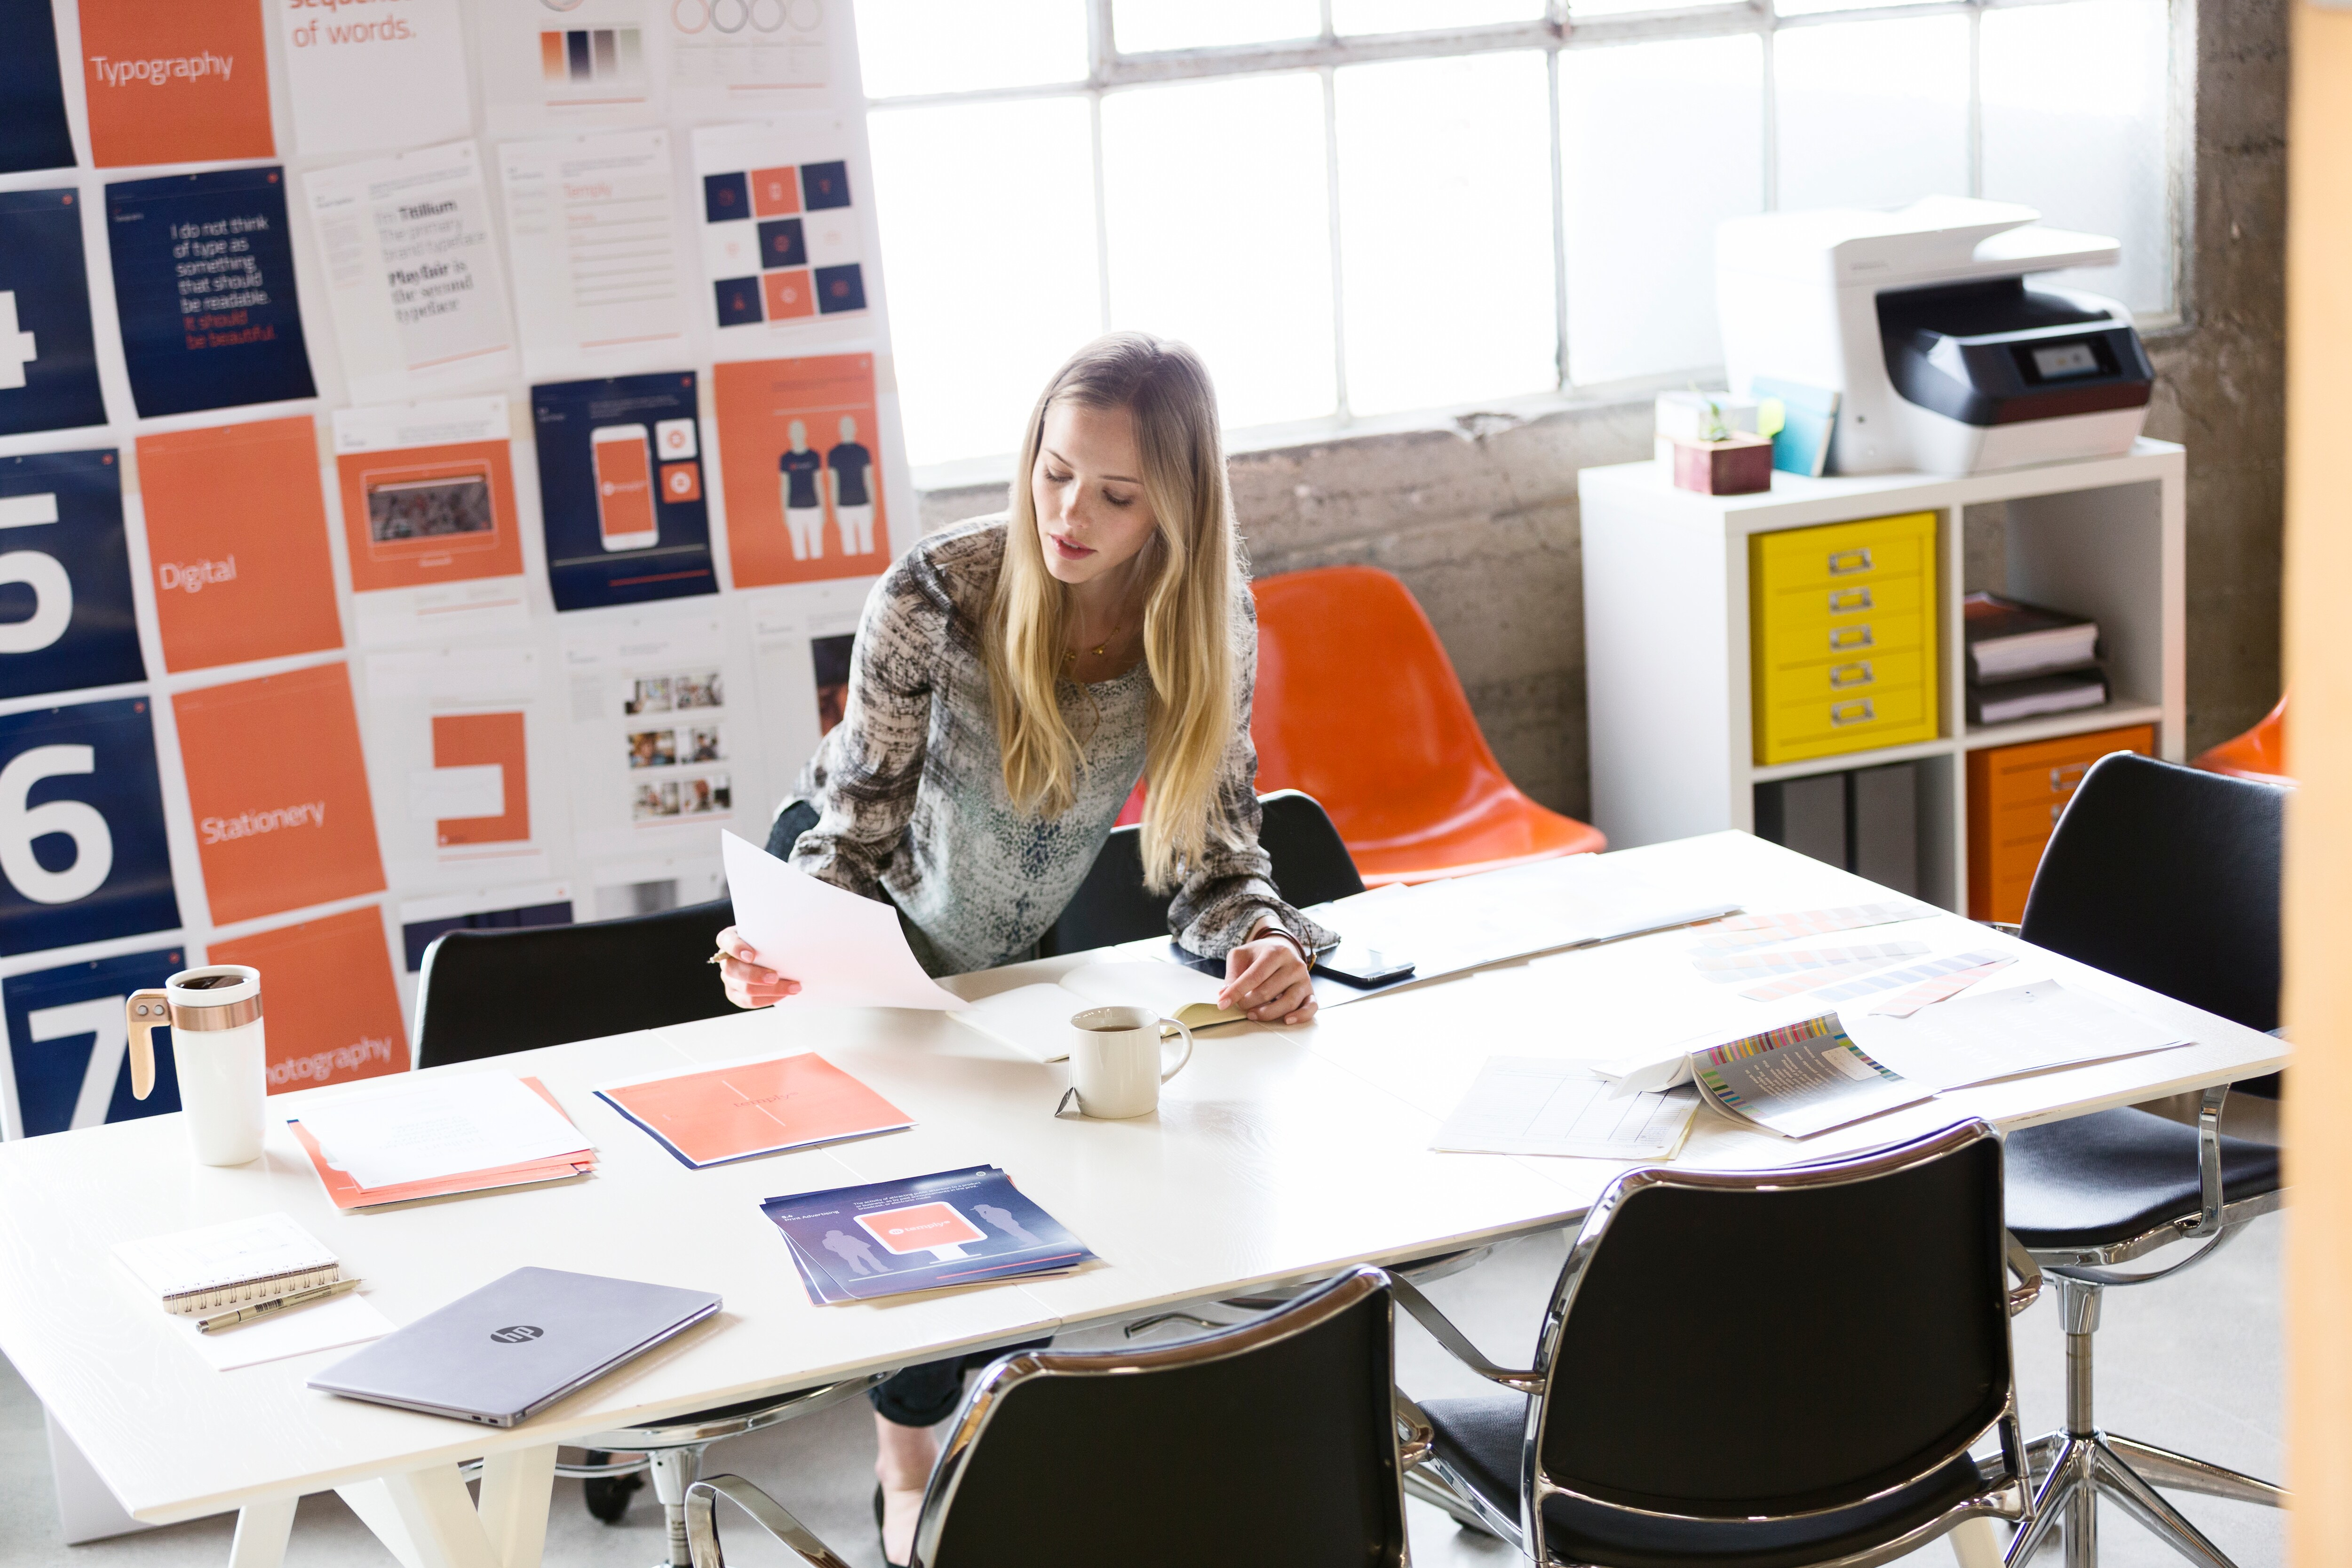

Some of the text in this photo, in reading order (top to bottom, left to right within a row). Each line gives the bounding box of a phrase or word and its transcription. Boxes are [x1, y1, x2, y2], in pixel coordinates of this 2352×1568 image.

[292, 14, 417, 48] of words.
[89, 49, 234, 88] Typography
[170, 213, 270, 240] I do not think
[173, 236, 250, 259] of type as
[177, 269, 263, 296] that should
[180, 287, 272, 314] be readable.
[198, 308, 249, 330] should
[185, 333, 207, 351] be
[0, 491, 74, 654] 5
[159, 553, 237, 594] Digital
[0, 743, 113, 905] 6
[200, 800, 325, 845] Stationery
[28, 995, 127, 1130] 7
[266, 1036, 392, 1085] otography
[1775, 1068, 1786, 1077] color
[1781, 1059, 1795, 1072] putting
[1783, 1054, 1798, 1069] advance
[1814, 1059, 1825, 1067] color
[1757, 1076, 1767, 1085] color
[911, 1190, 950, 1199] announcements
[802, 1210, 840, 1219] Advertising
[491, 1325, 544, 1343] hp
